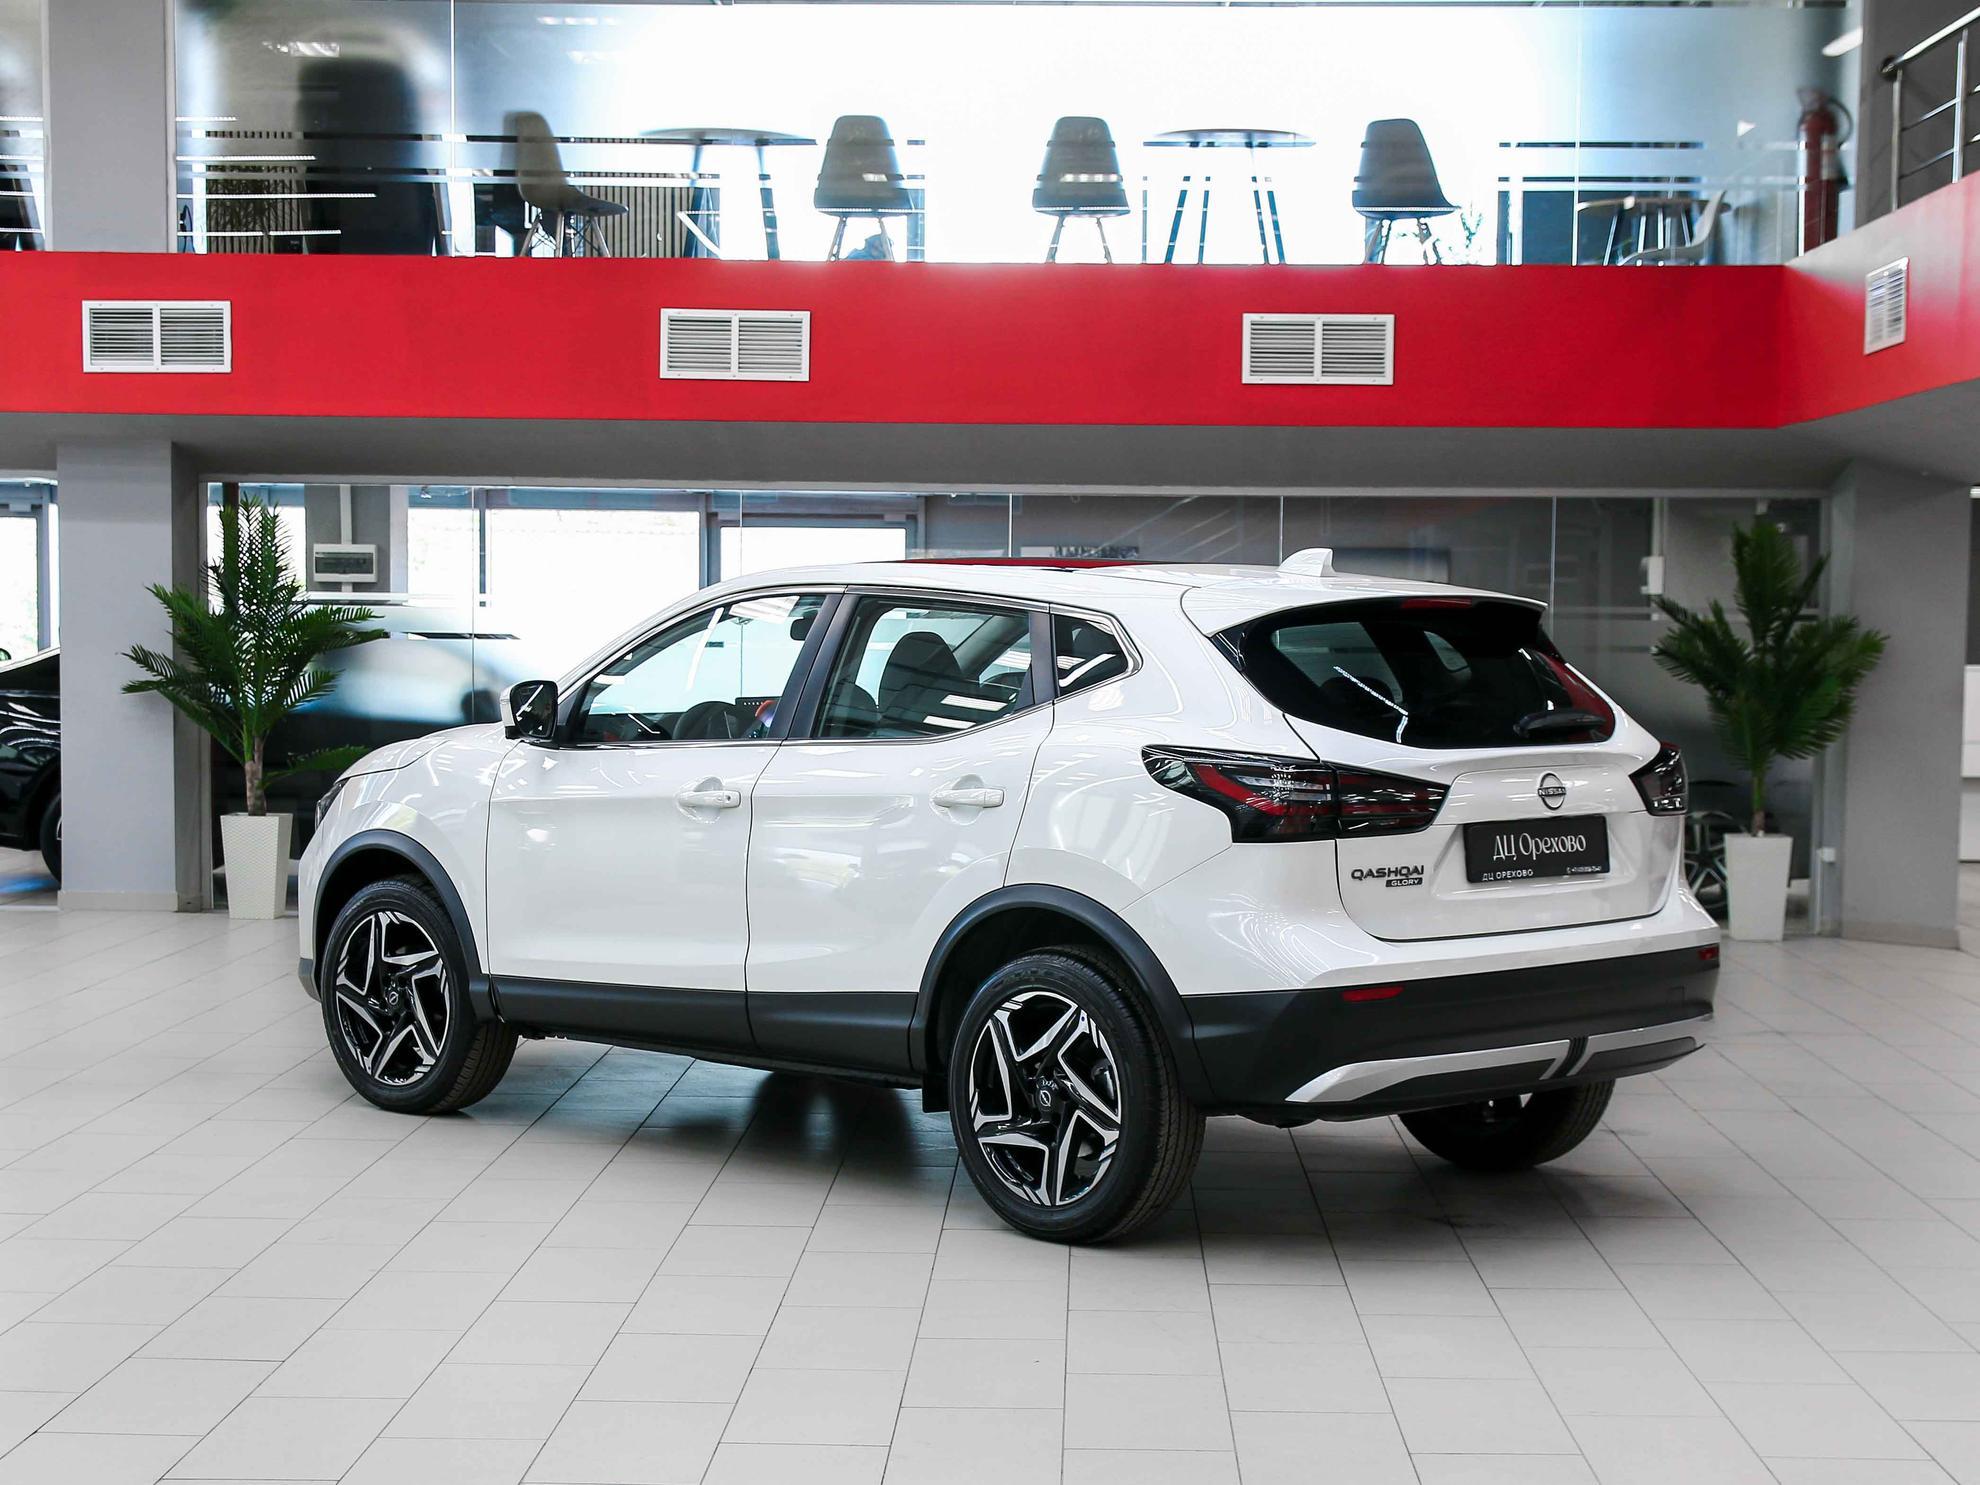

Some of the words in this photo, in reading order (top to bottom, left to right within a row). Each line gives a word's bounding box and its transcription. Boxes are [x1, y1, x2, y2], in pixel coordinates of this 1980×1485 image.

[1538, 788, 1566, 796] NISSAN
[1493, 834, 1517, 861] ДЦ
[1519, 833, 1587, 860] Орехово
[1351, 865, 1424, 881] QASHQAI
[1482, 873, 1494, 881] ДЦ
[1495, 869, 1534, 879] ОРЕХОВО
